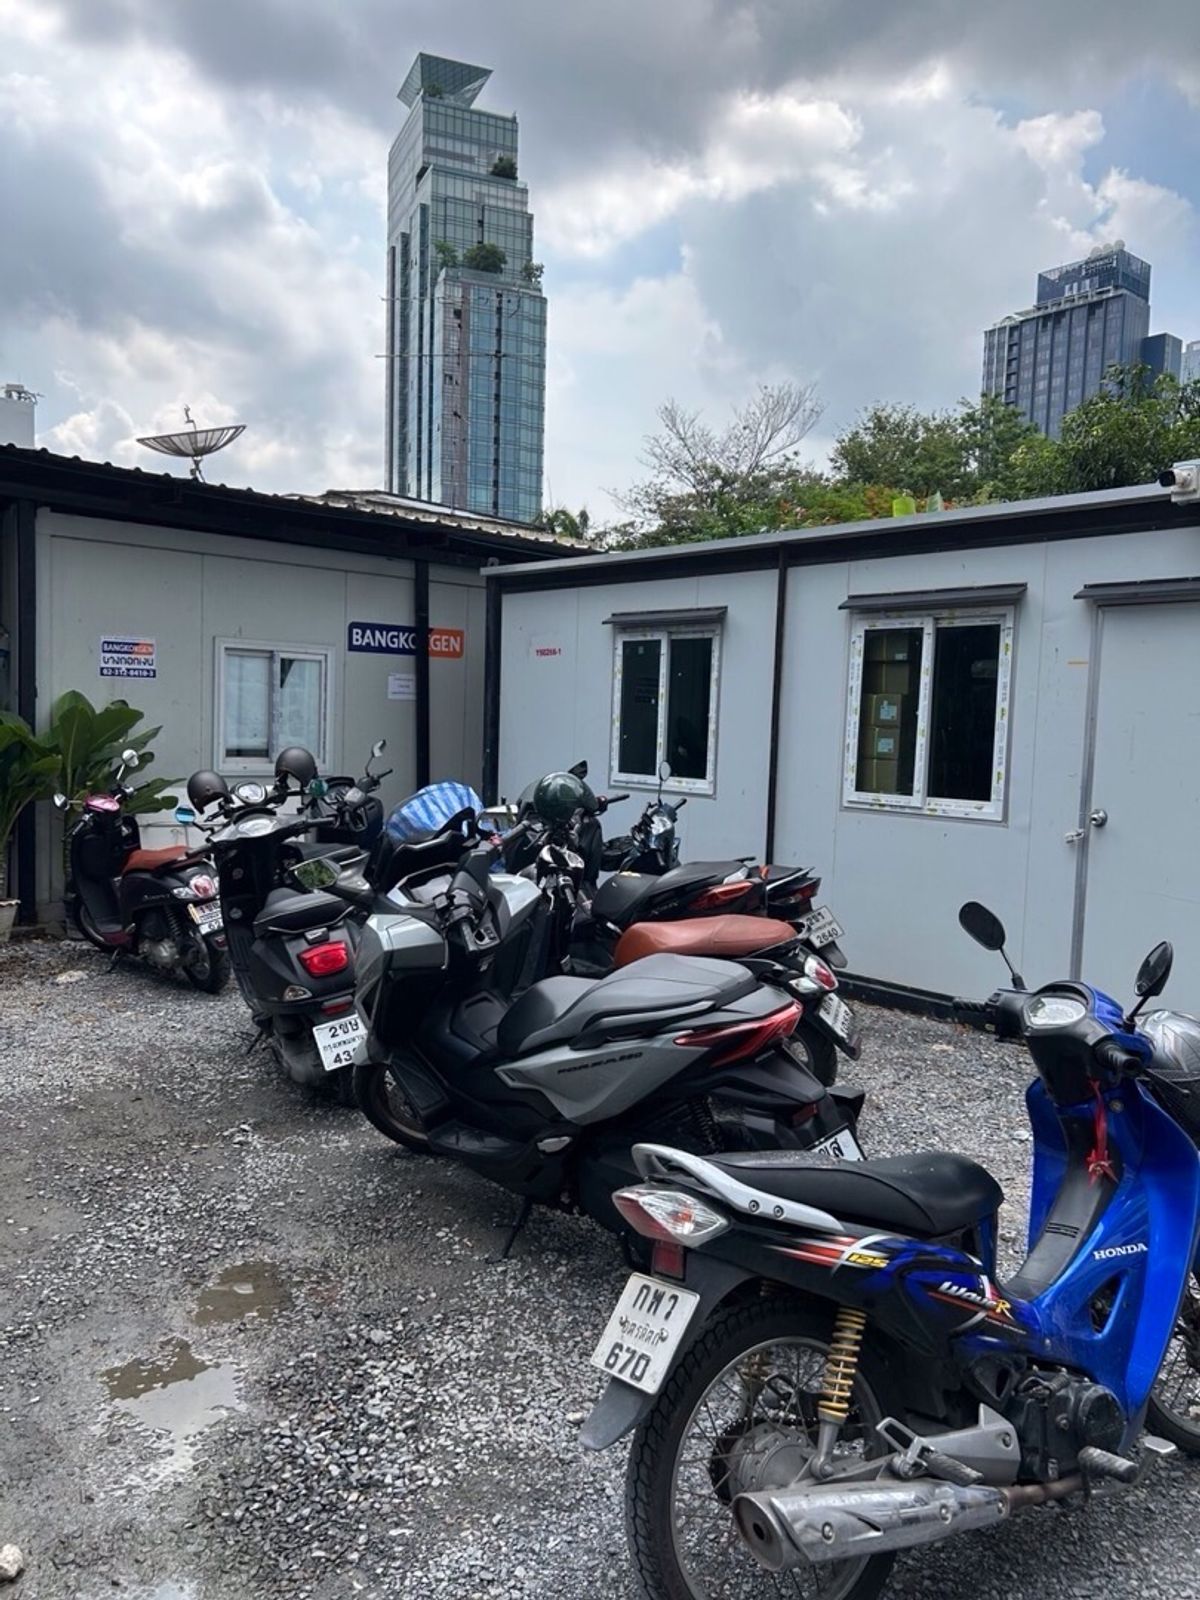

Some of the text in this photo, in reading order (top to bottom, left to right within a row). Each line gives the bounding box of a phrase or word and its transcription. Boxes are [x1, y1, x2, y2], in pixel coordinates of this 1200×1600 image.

[351, 627, 461, 652] BANGKOGEN
[816, 927, 839, 944] 2640
[333, 1047, 357, 1065] 43
[1092, 1242, 1149, 1261] HONDA
[604, 1341, 652, 1383] 670
